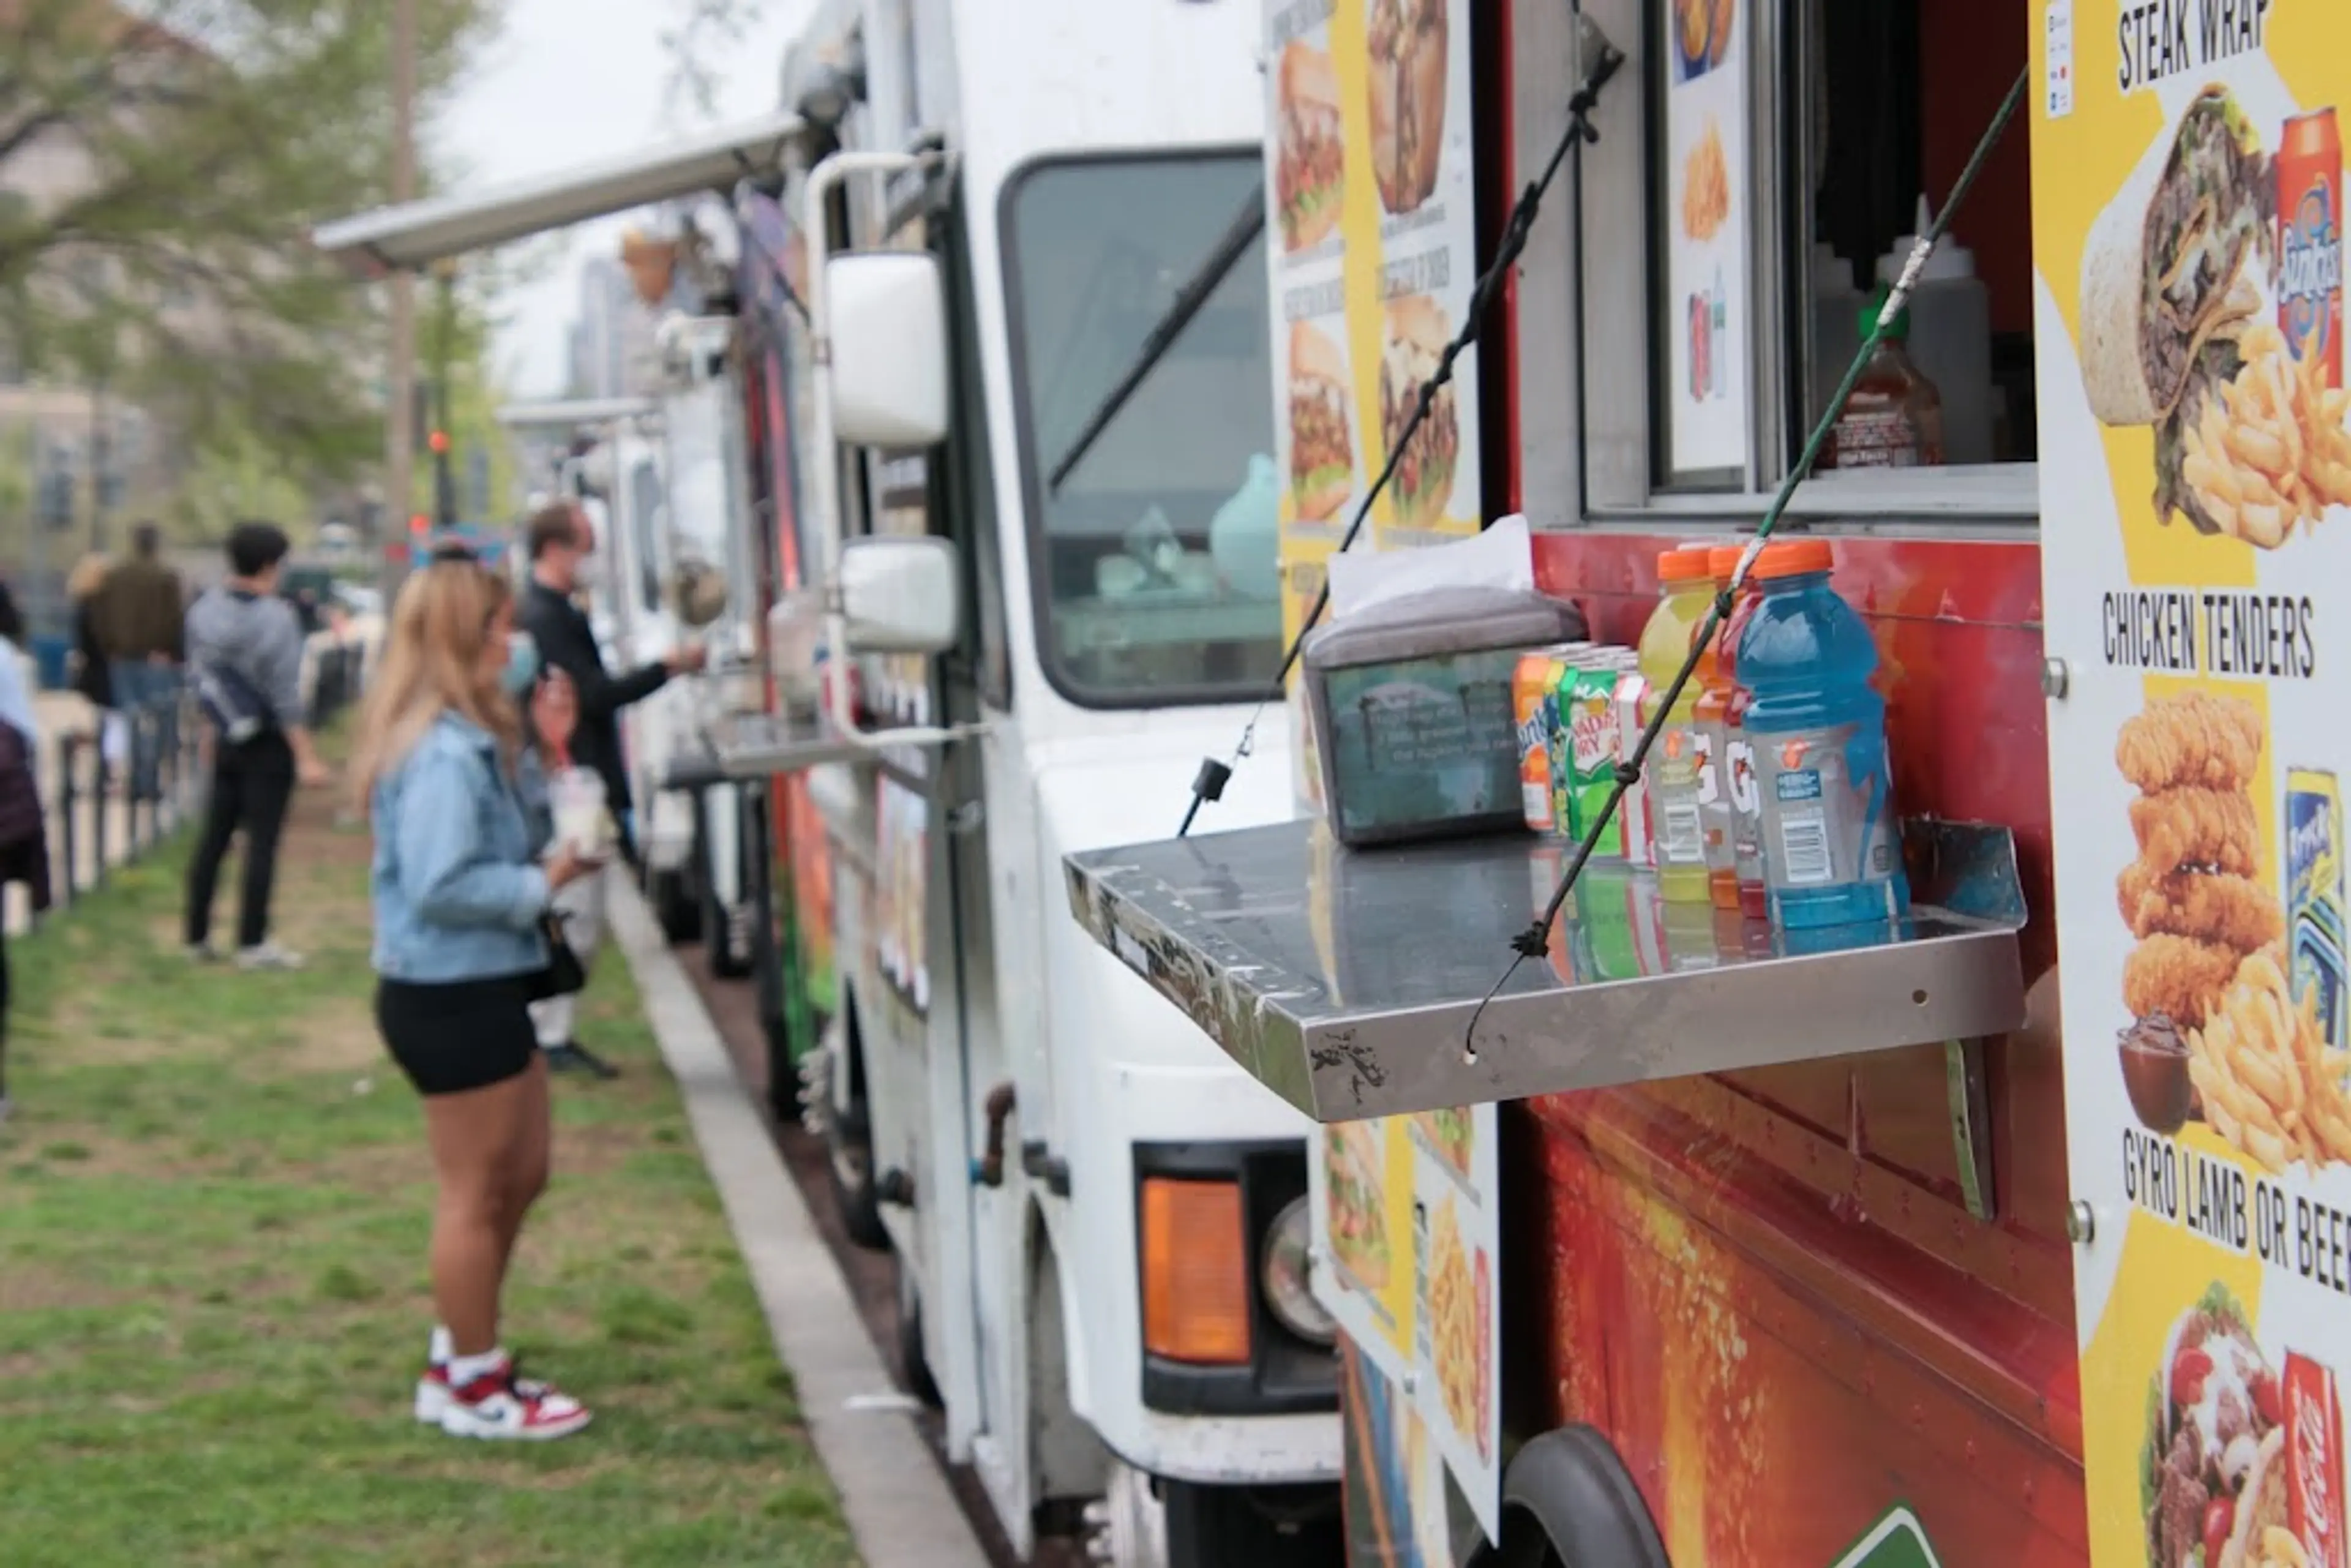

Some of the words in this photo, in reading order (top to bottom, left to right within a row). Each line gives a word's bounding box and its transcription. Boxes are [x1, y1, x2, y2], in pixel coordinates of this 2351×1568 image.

[2120, 0, 2190, 90] STEAK
[2199, 0, 2267, 64] WRAP
[2102, 591, 2195, 670] CHICKEN
[2203, 593, 2315, 678] TENDERS
[2123, 1127, 2178, 1219] GYRO
[2184, 1150, 2248, 1250] LAMB
[2255, 1179, 2290, 1270] OR
[2297, 1195, 2351, 1296] BEE
